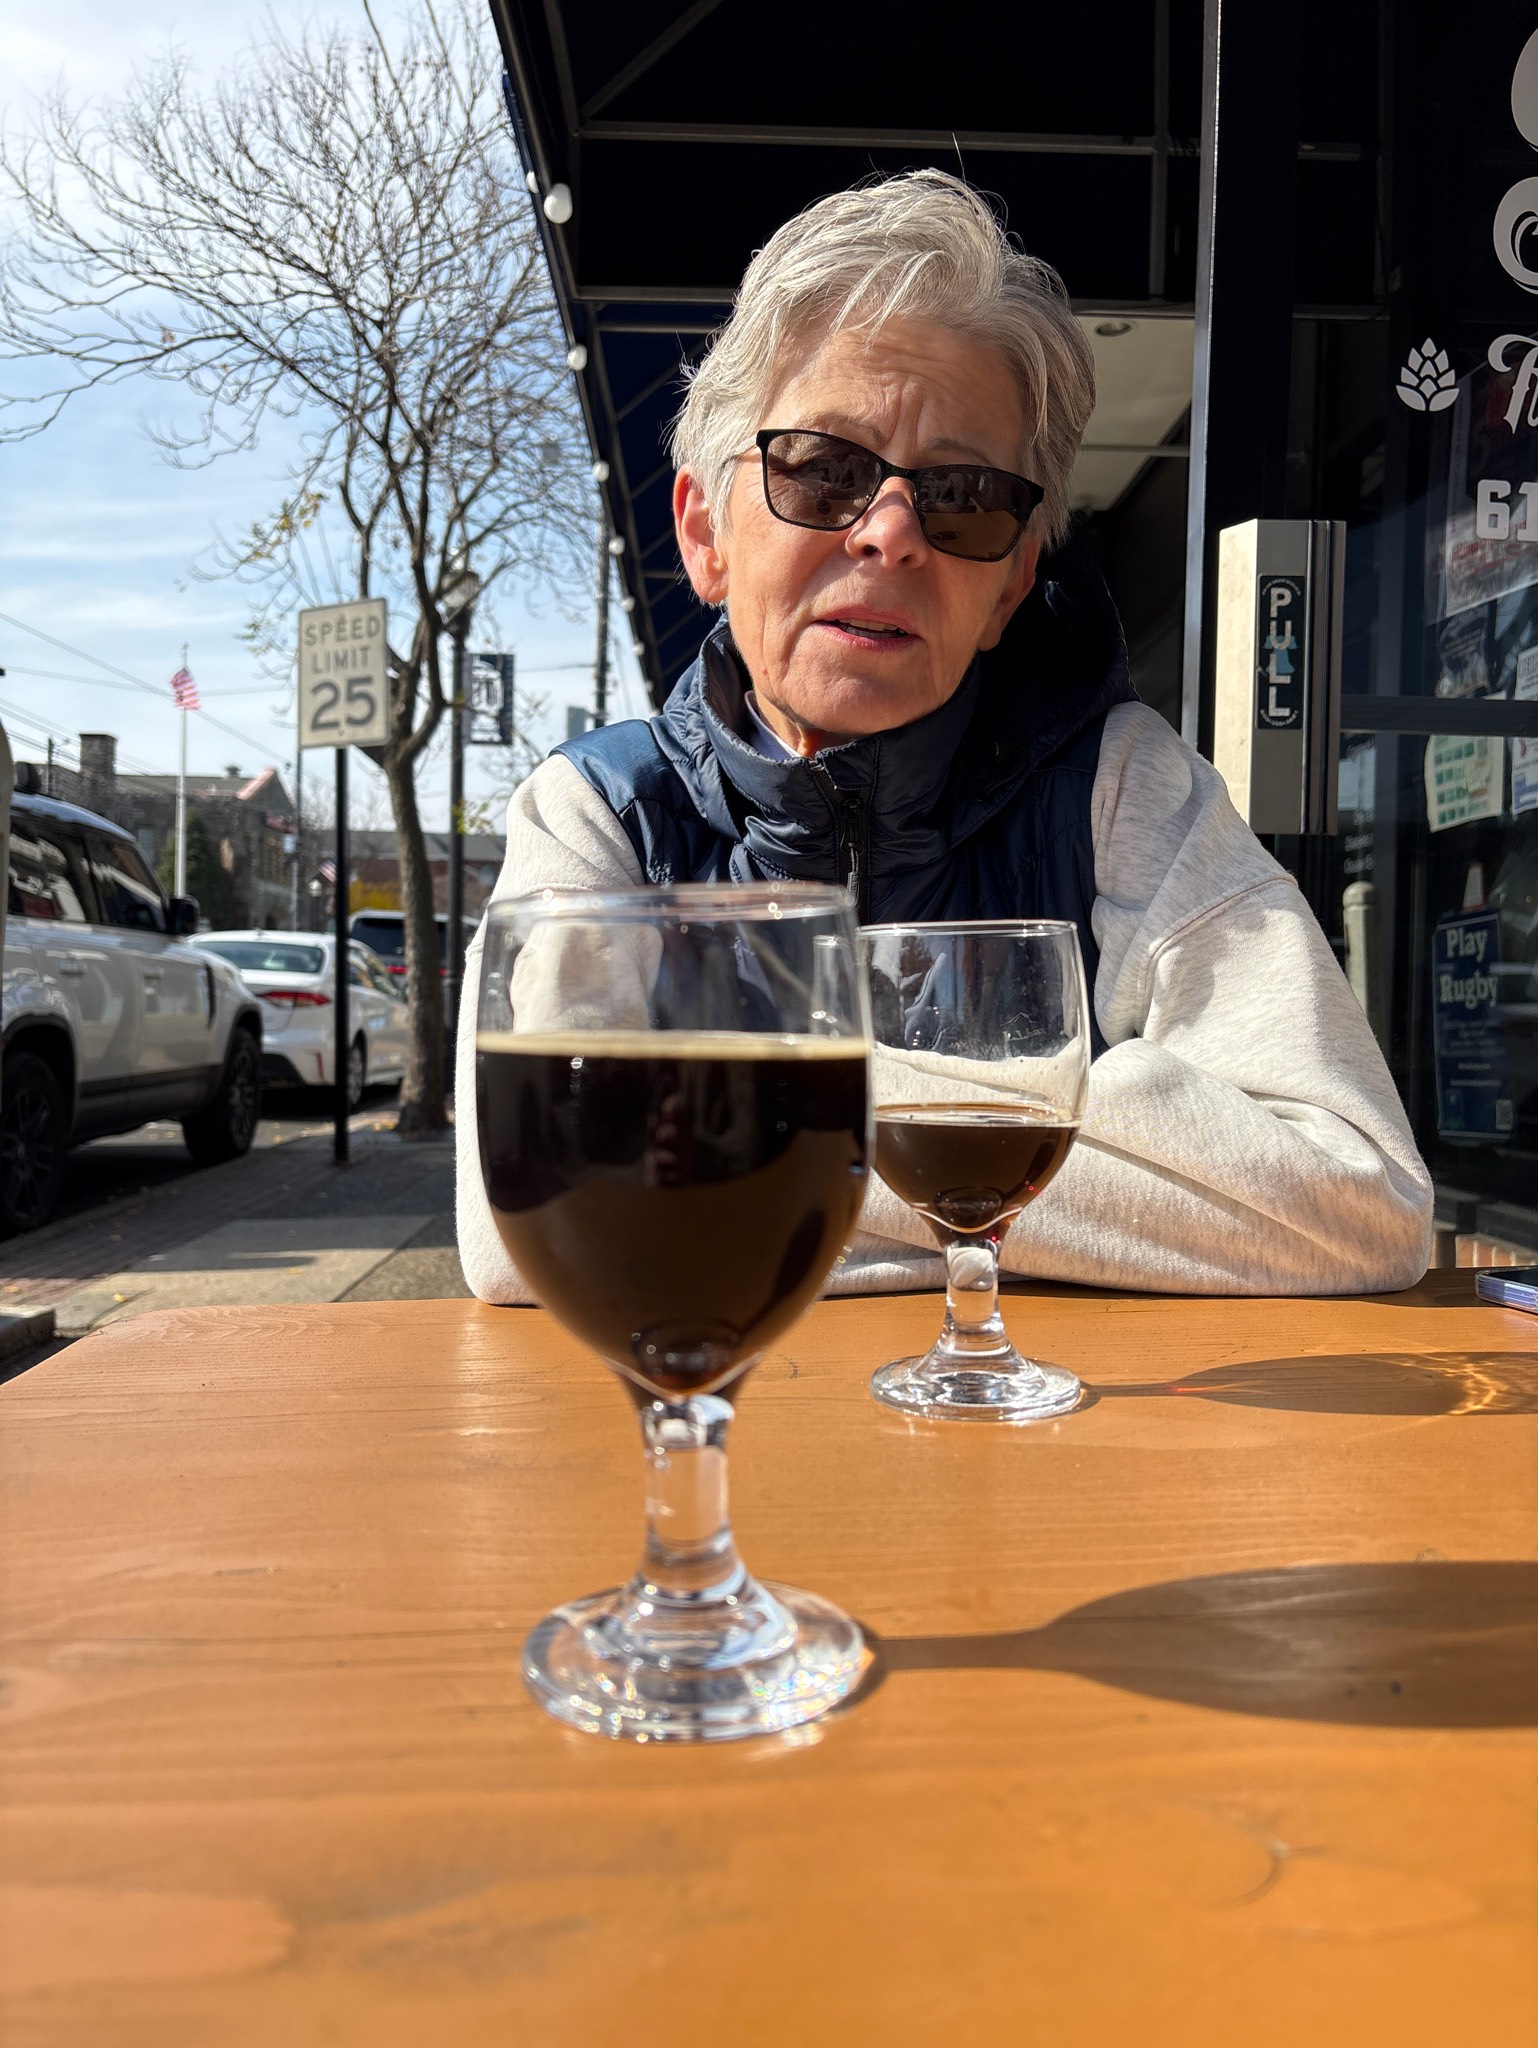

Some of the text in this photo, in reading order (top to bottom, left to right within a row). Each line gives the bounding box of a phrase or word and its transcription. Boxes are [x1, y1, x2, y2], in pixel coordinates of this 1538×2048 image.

[304, 615, 380, 647] SPEED
[311, 645, 368, 674] LIMIT
[1268, 587, 1292, 717] PULL
[310, 676, 377, 732] 25
[1446, 927, 1487, 963] Play
[1440, 969, 1498, 1010] Rugby
